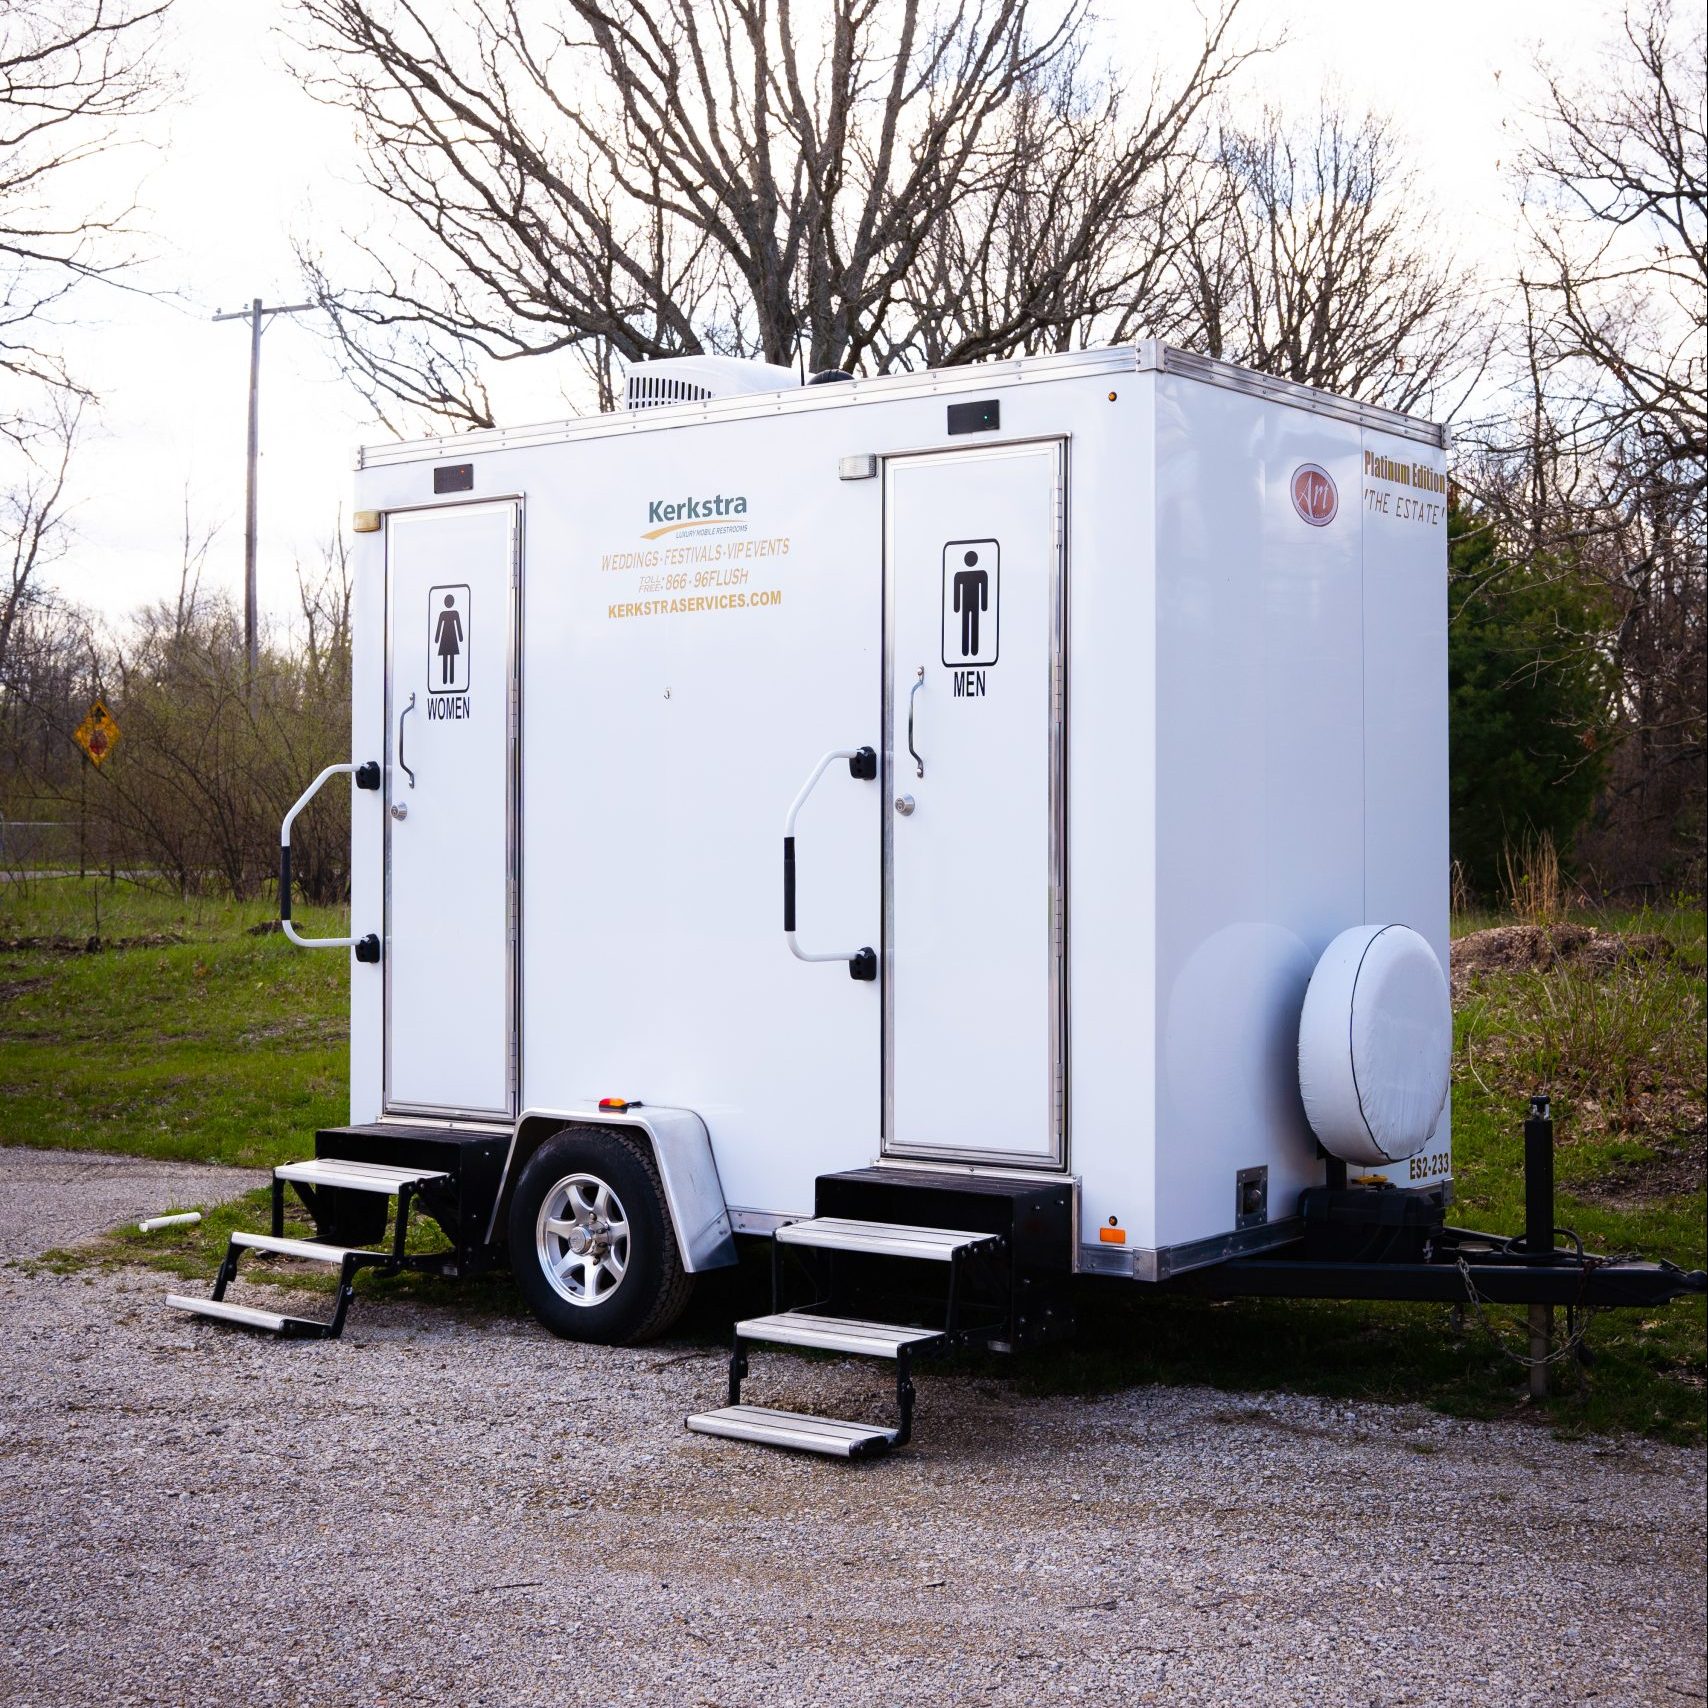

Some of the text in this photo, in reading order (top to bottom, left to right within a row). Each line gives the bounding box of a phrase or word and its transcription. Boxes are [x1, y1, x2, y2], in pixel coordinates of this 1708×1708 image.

[1364, 450, 1446, 495] Platinum Edition
[648, 494, 748, 523] Kerkstra
[675, 524, 748, 539] LUXURY MOBILE RESTROOMS
[745, 537, 790, 558] EVENTS
[608, 590, 782, 619] KERKSTRASERVICES.COM
[953, 670, 986, 697] MEN
[427, 696, 470, 720] WOMEN
[1409, 1152, 1449, 1180] ES2-233
